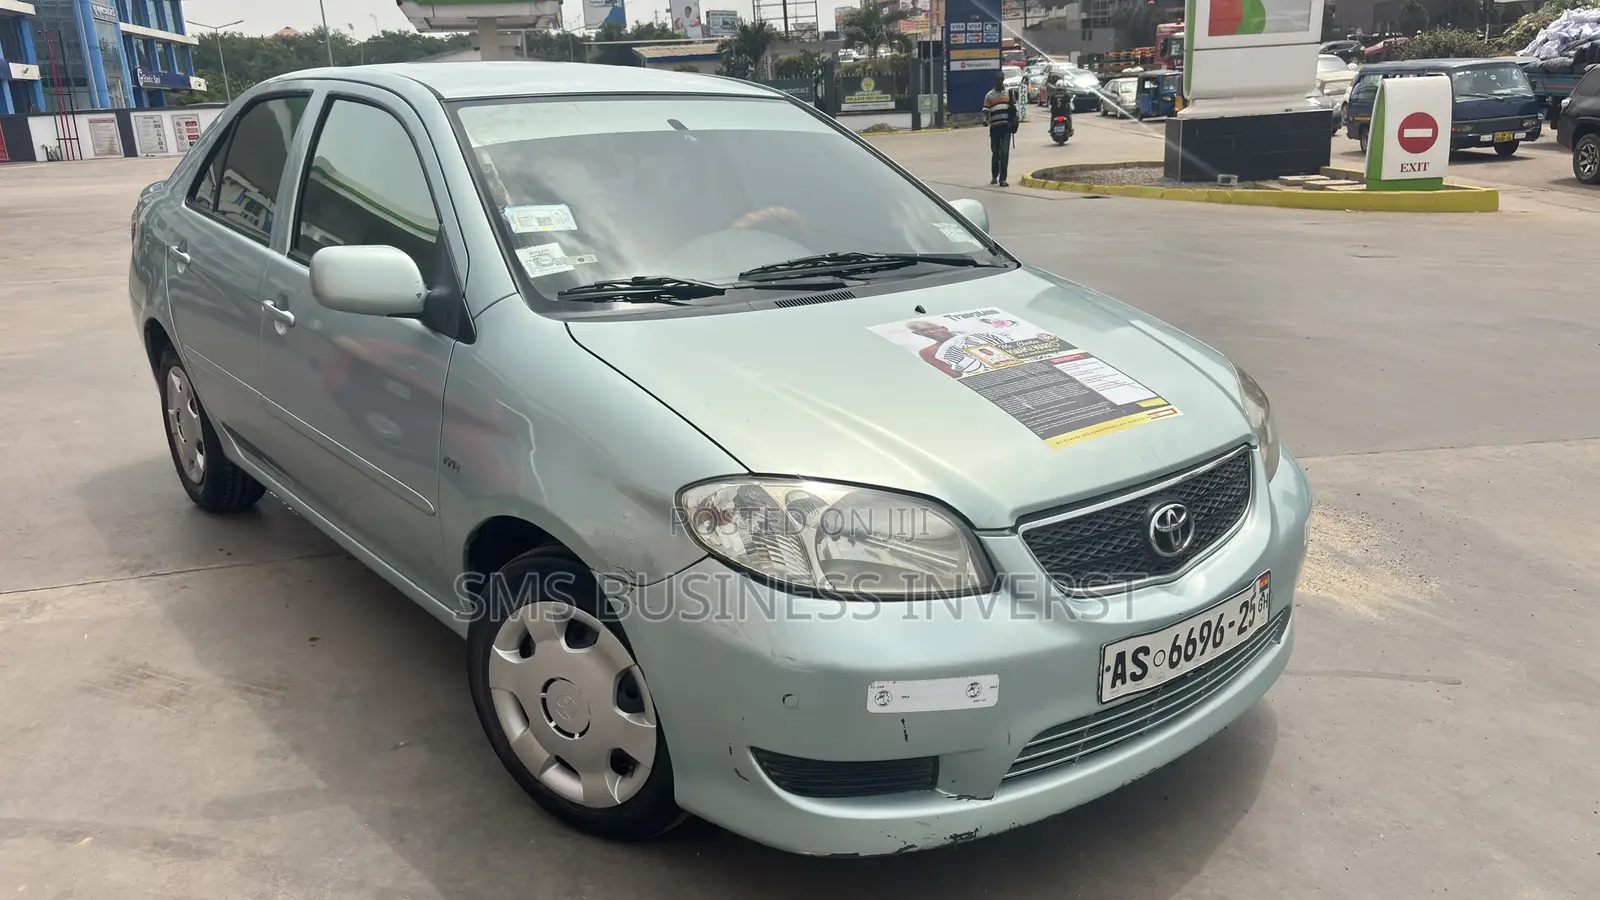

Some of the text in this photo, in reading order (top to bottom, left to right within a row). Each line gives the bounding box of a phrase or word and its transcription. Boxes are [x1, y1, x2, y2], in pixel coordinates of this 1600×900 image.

[1400, 161, 1429, 173] EXIT
[1258, 592, 1269, 613] GH
[1110, 646, 1150, 689] AS
